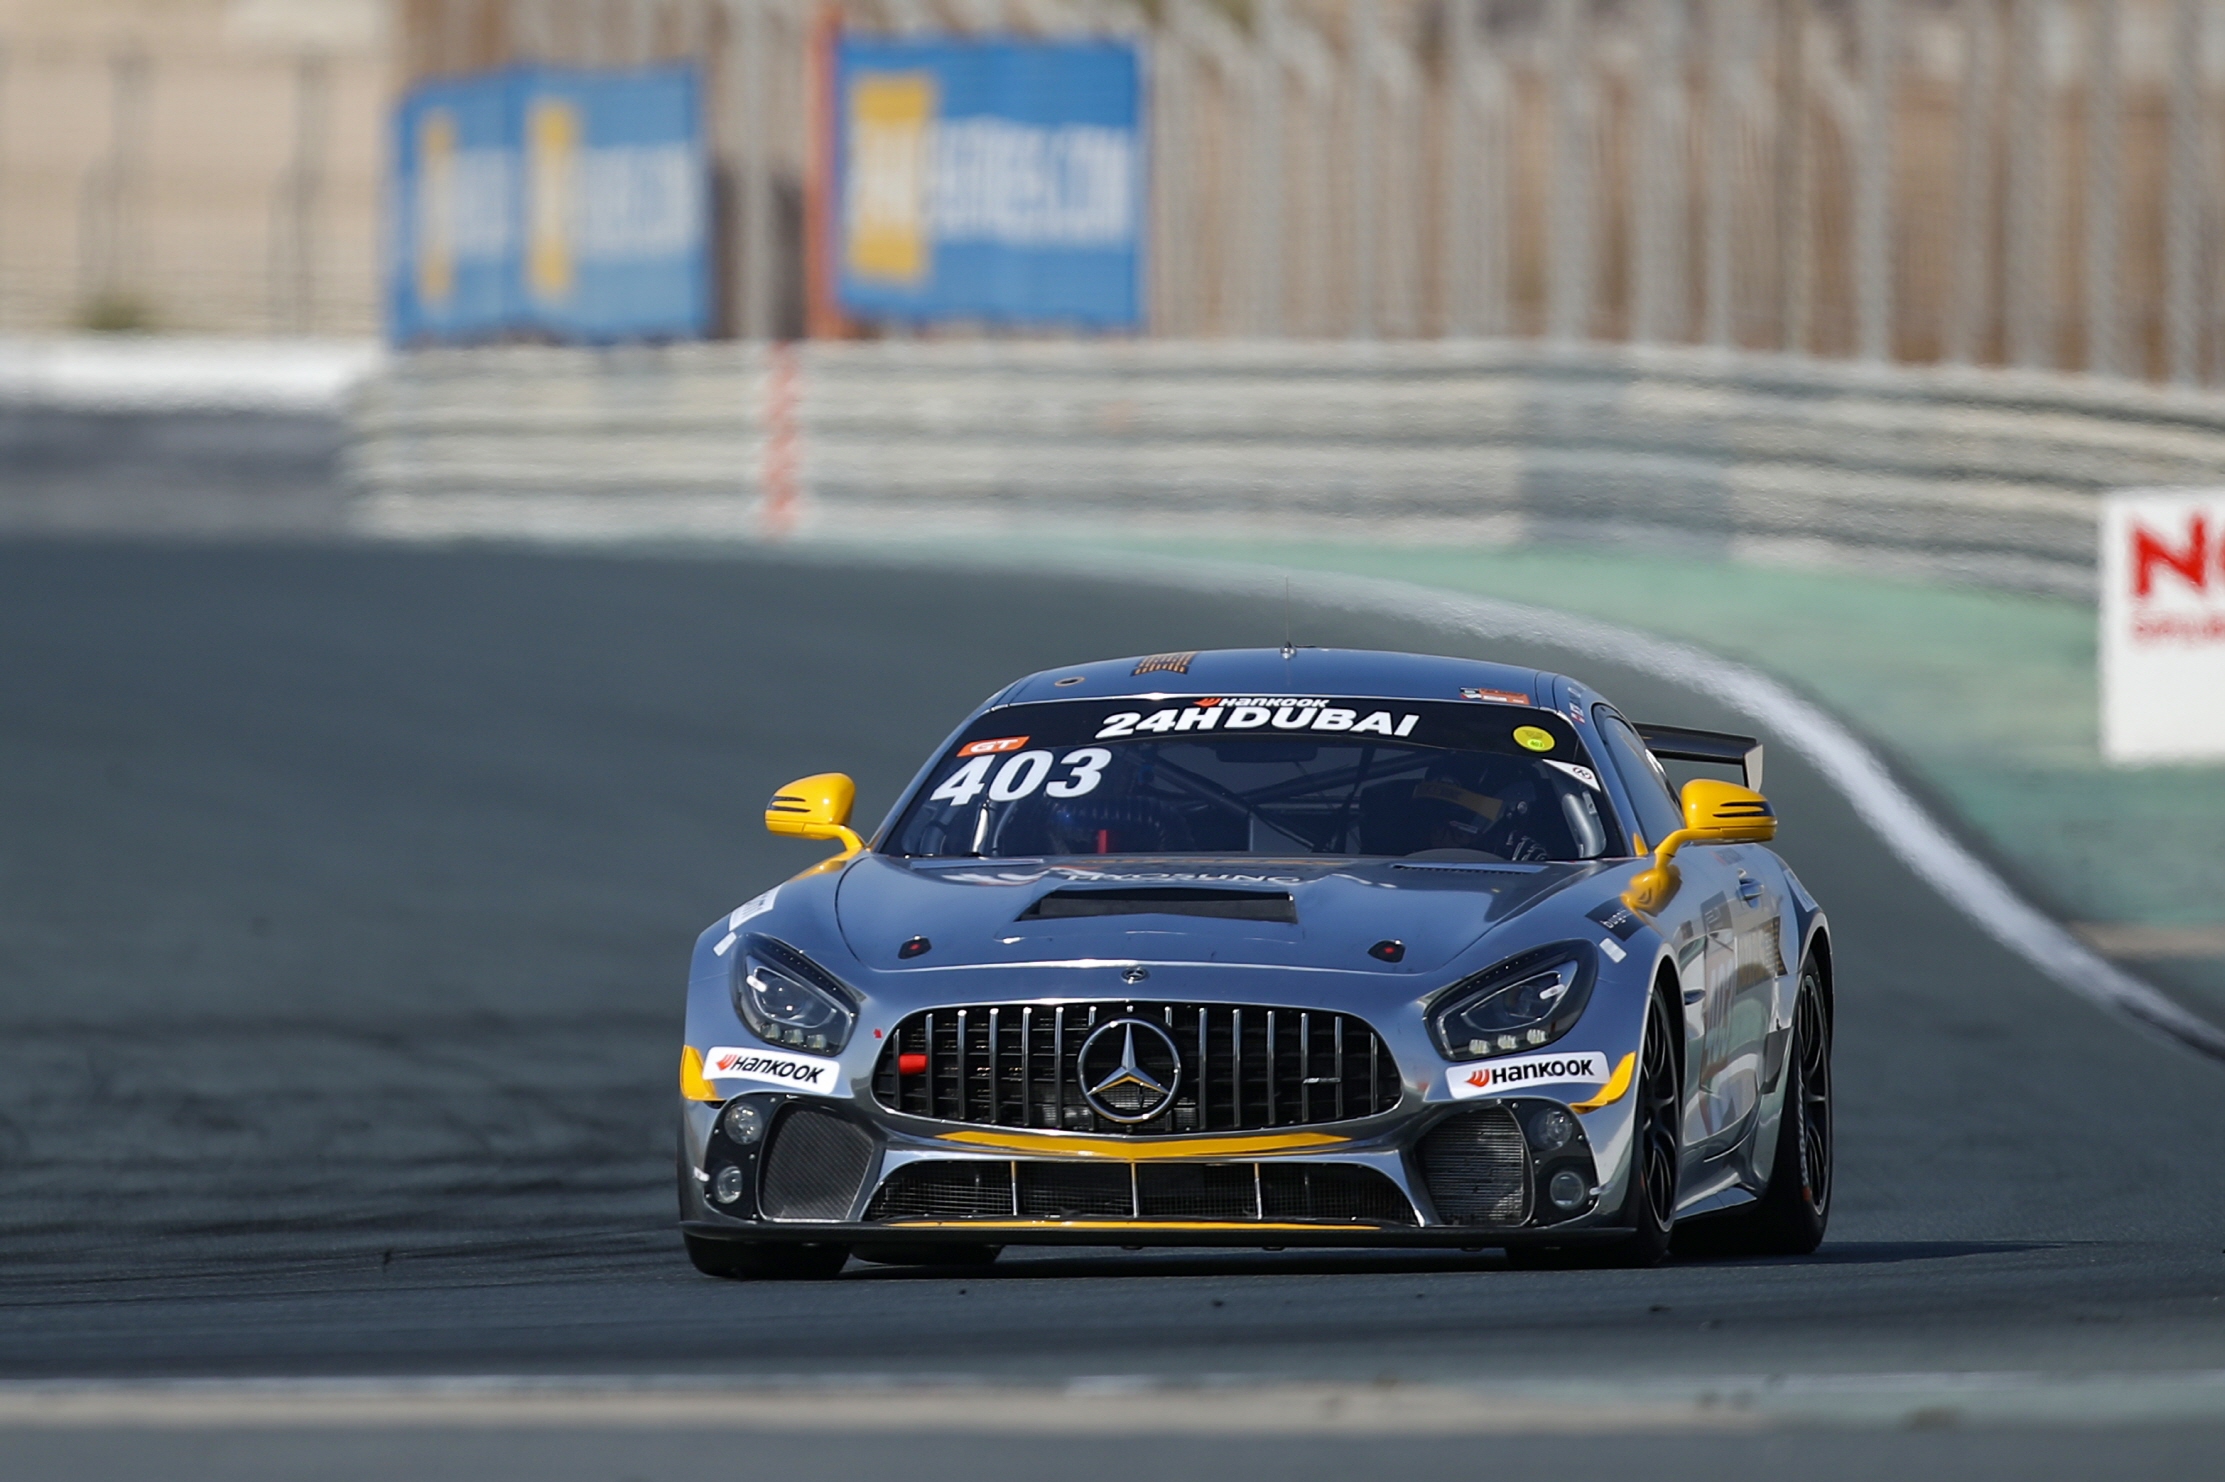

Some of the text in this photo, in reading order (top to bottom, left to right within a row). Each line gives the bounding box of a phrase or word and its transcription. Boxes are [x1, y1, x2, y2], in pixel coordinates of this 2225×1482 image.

[2131, 515, 2225, 596] N
[970, 739, 1020, 753] GT
[929, 747, 1112, 806] 403
